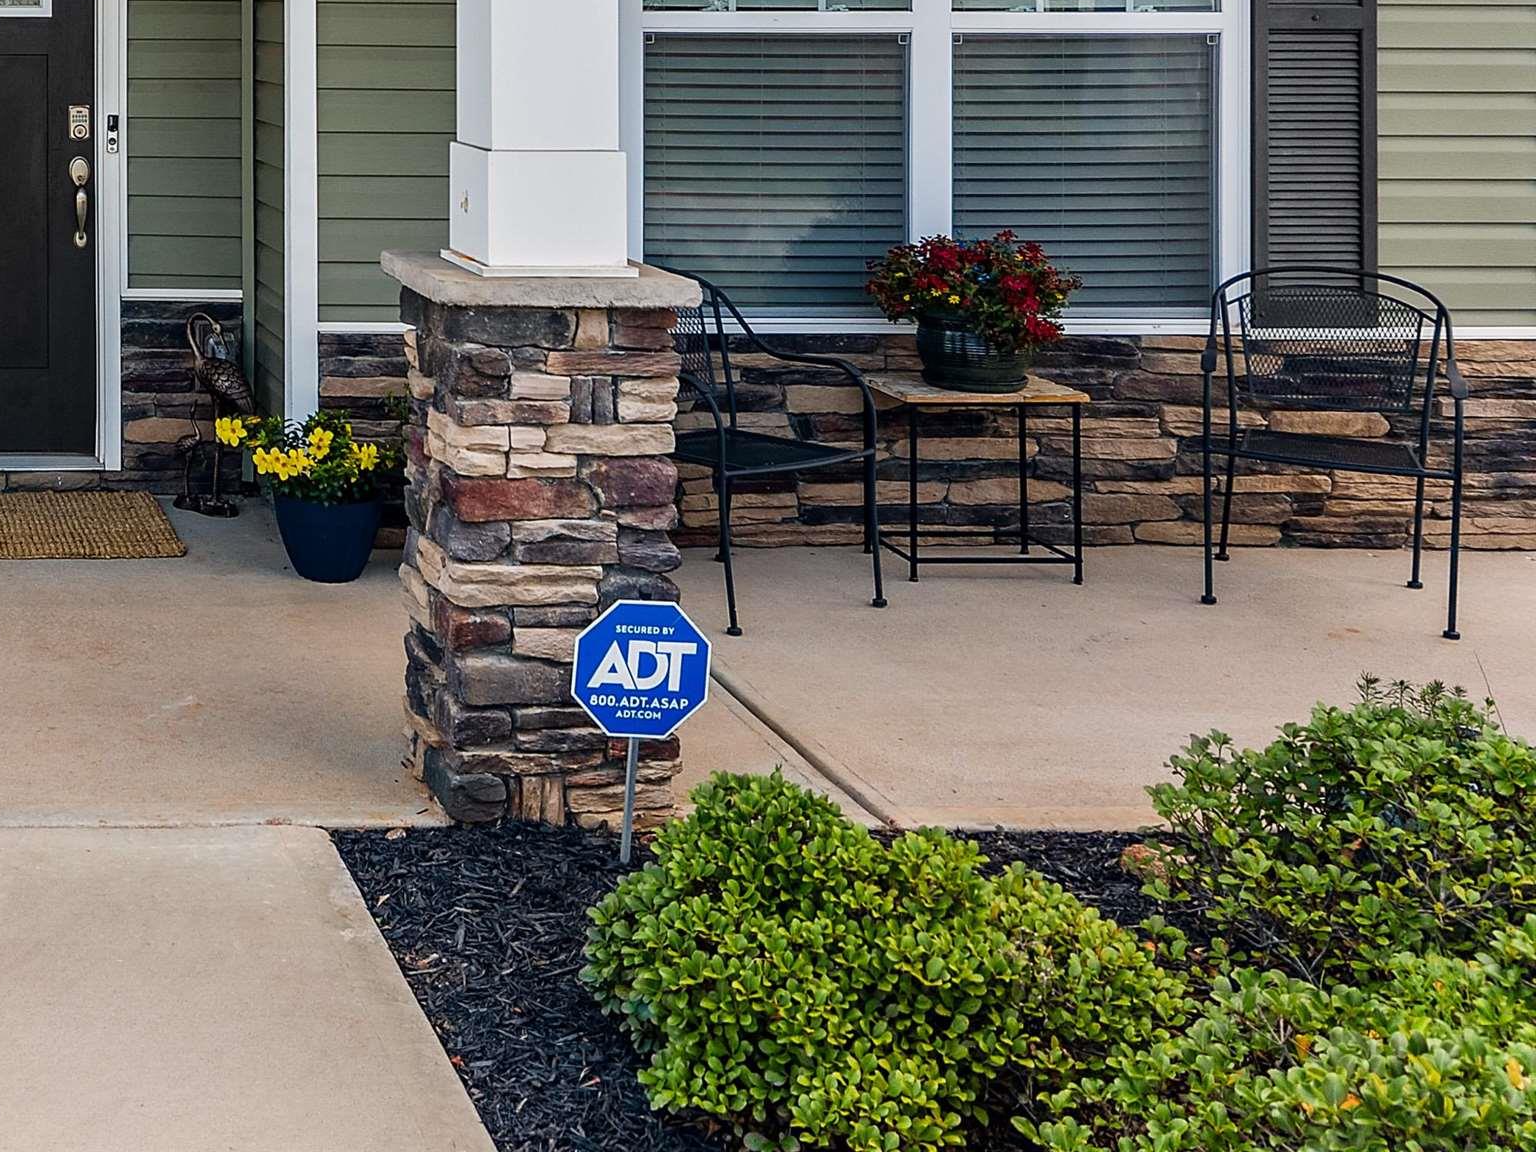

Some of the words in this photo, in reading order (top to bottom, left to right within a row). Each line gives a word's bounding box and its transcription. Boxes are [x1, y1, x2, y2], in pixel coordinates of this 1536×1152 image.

[615, 624, 660, 635] SECURED
[662, 626, 675, 635] BY
[586, 639, 698, 692] ADT
[589, 694, 689, 710] 800.ADT.ASAP
[615, 710, 662, 720] ADT.COM
